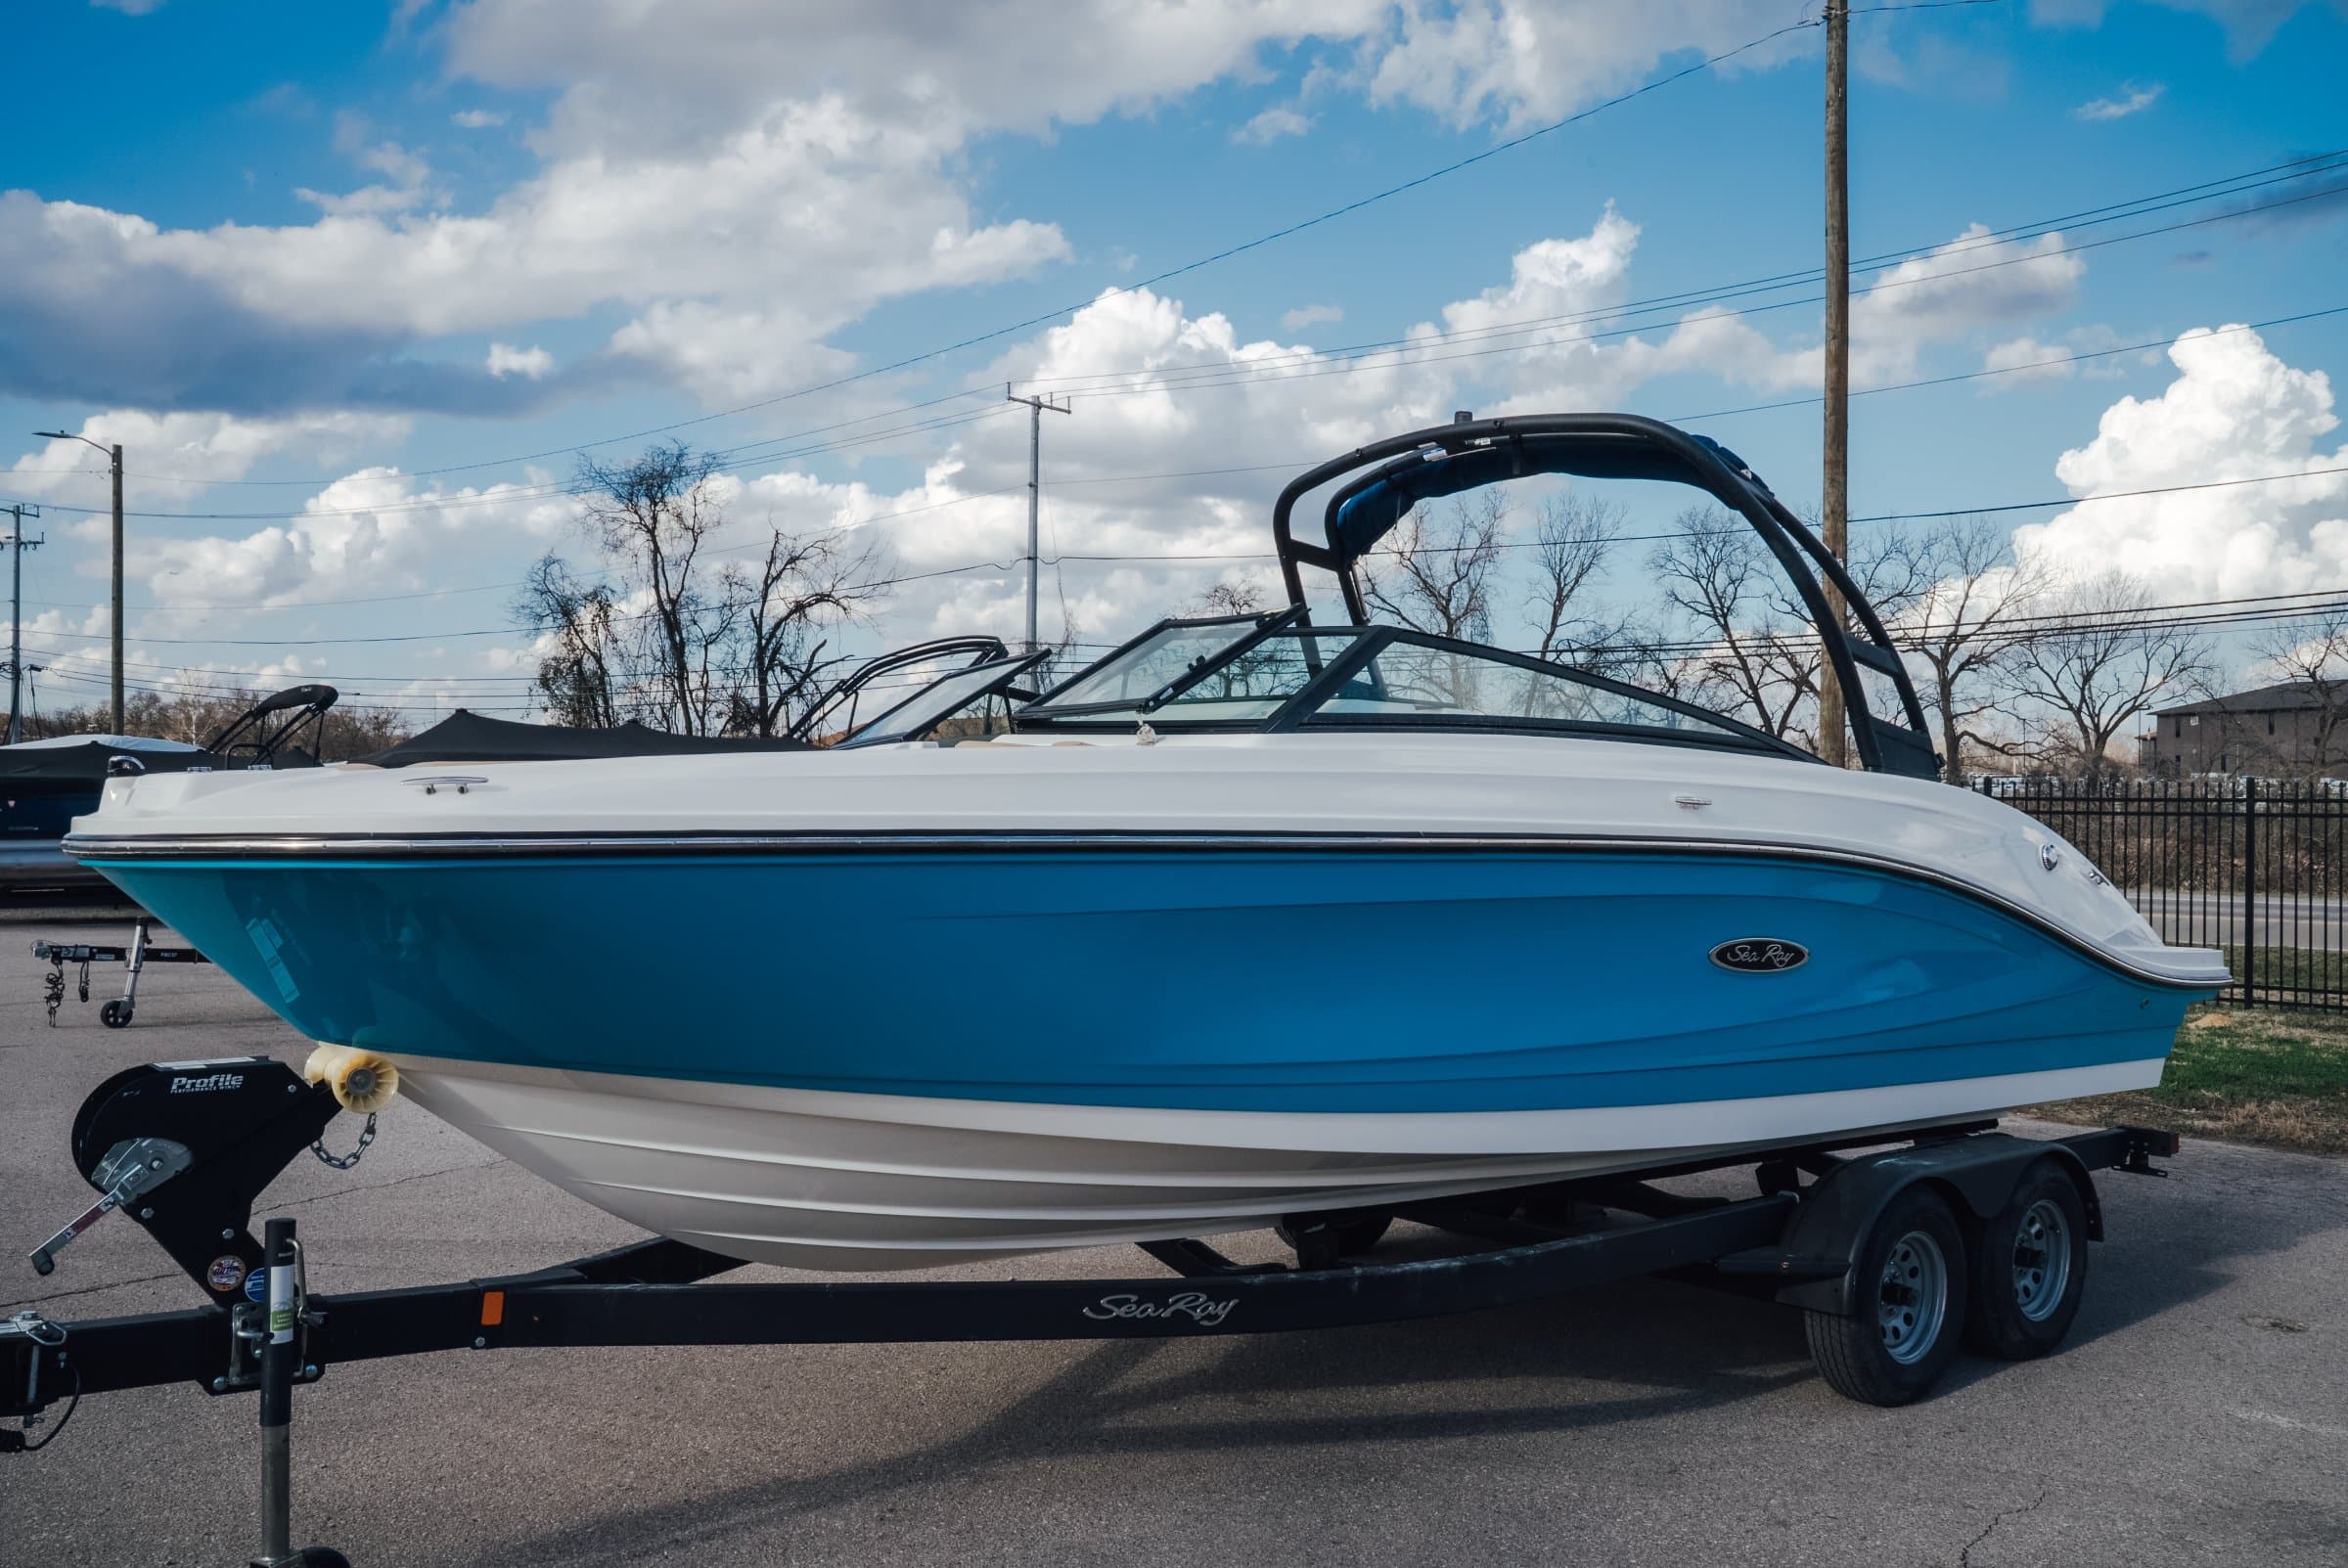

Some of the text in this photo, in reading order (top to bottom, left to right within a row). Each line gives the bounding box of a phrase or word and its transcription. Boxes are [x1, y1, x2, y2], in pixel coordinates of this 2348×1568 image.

[1727, 943, 1794, 967] Sea Ray
[171, 1074, 244, 1090] Profile
[1082, 1292, 1240, 1326] Sea Ray
